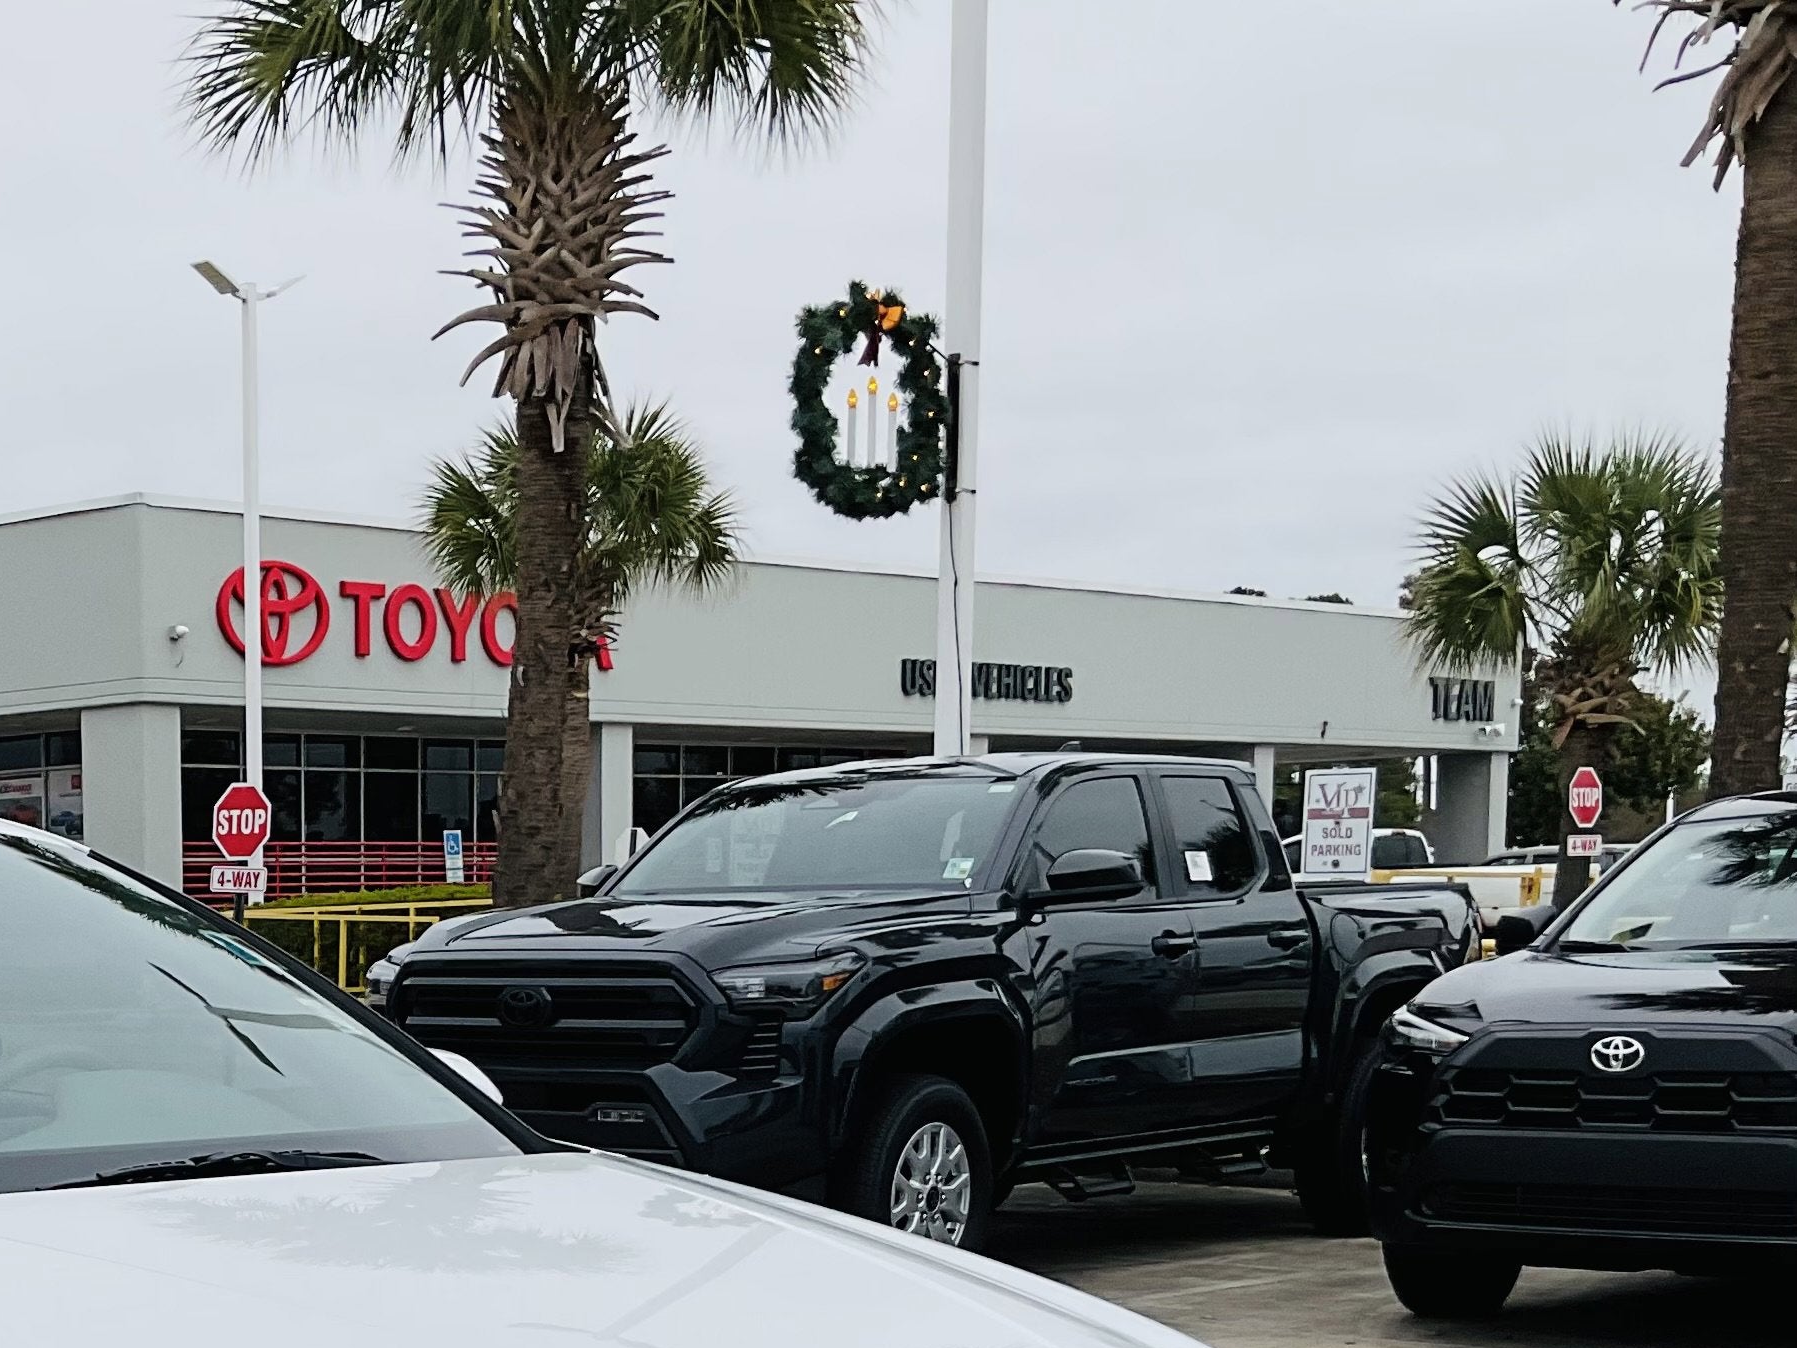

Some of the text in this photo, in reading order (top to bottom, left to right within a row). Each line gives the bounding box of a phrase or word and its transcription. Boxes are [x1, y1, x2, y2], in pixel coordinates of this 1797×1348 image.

[339, 580, 614, 671] TOYO
[971, 661, 1073, 702] VEHICLES
[1428, 677, 1495, 721] TEAM
[1572, 787, 1599, 808] STOP
[217, 808, 266, 835] STOP
[1322, 827, 1353, 839] SOLD
[1311, 844, 1362, 857] PARKING
[1571, 839, 1598, 852] 4-WAY
[217, 870, 261, 889] 4-WAY
